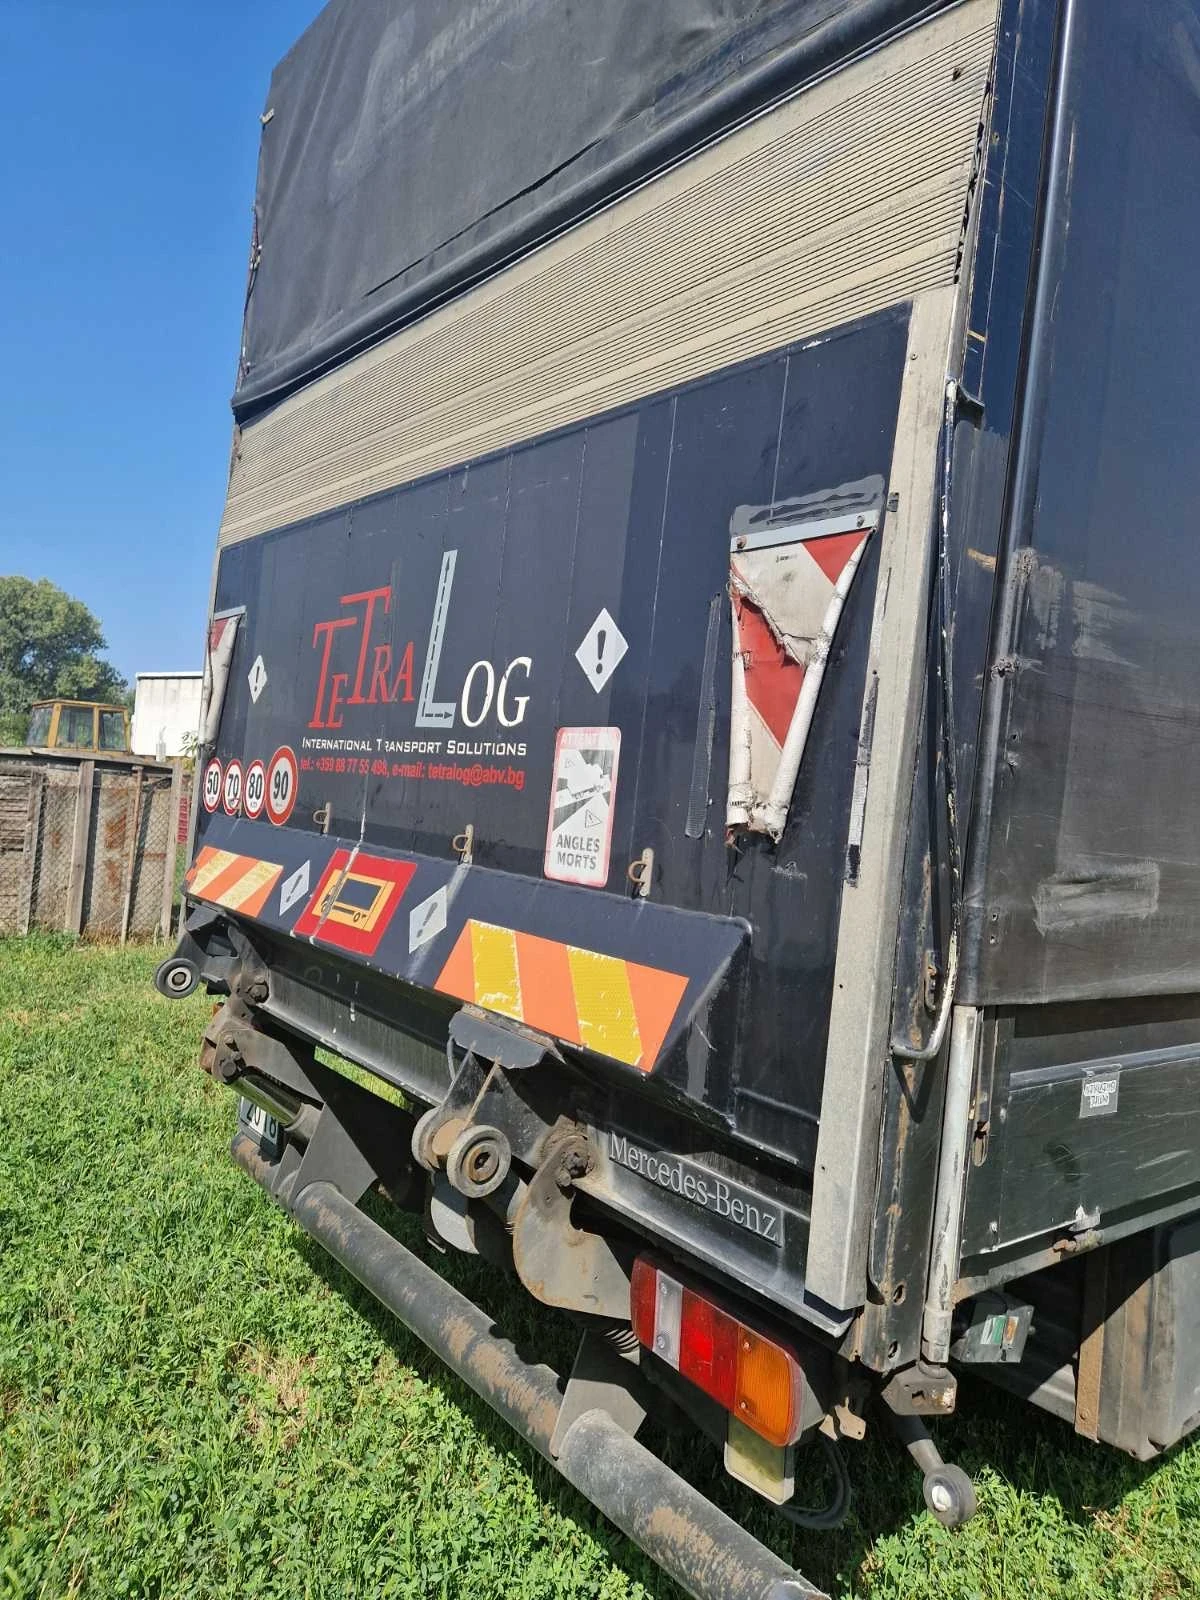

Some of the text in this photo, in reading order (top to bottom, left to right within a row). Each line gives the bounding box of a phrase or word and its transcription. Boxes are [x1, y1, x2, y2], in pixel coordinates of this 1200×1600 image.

[302, 737, 527, 756] INTERNATIONAL TRANSPORT SOLUTIONS
[207, 771, 219, 795] 50
[228, 773, 240, 797] 70
[248, 773, 263, 800] 80
[273, 770, 289, 800] 90
[428, 762, 525, 790] tetralog@abv.bg
[556, 834, 601, 853] ANGLES
[557, 852, 597, 870] MORTS
[609, 1130, 779, 1241] Mercedes-Benz
